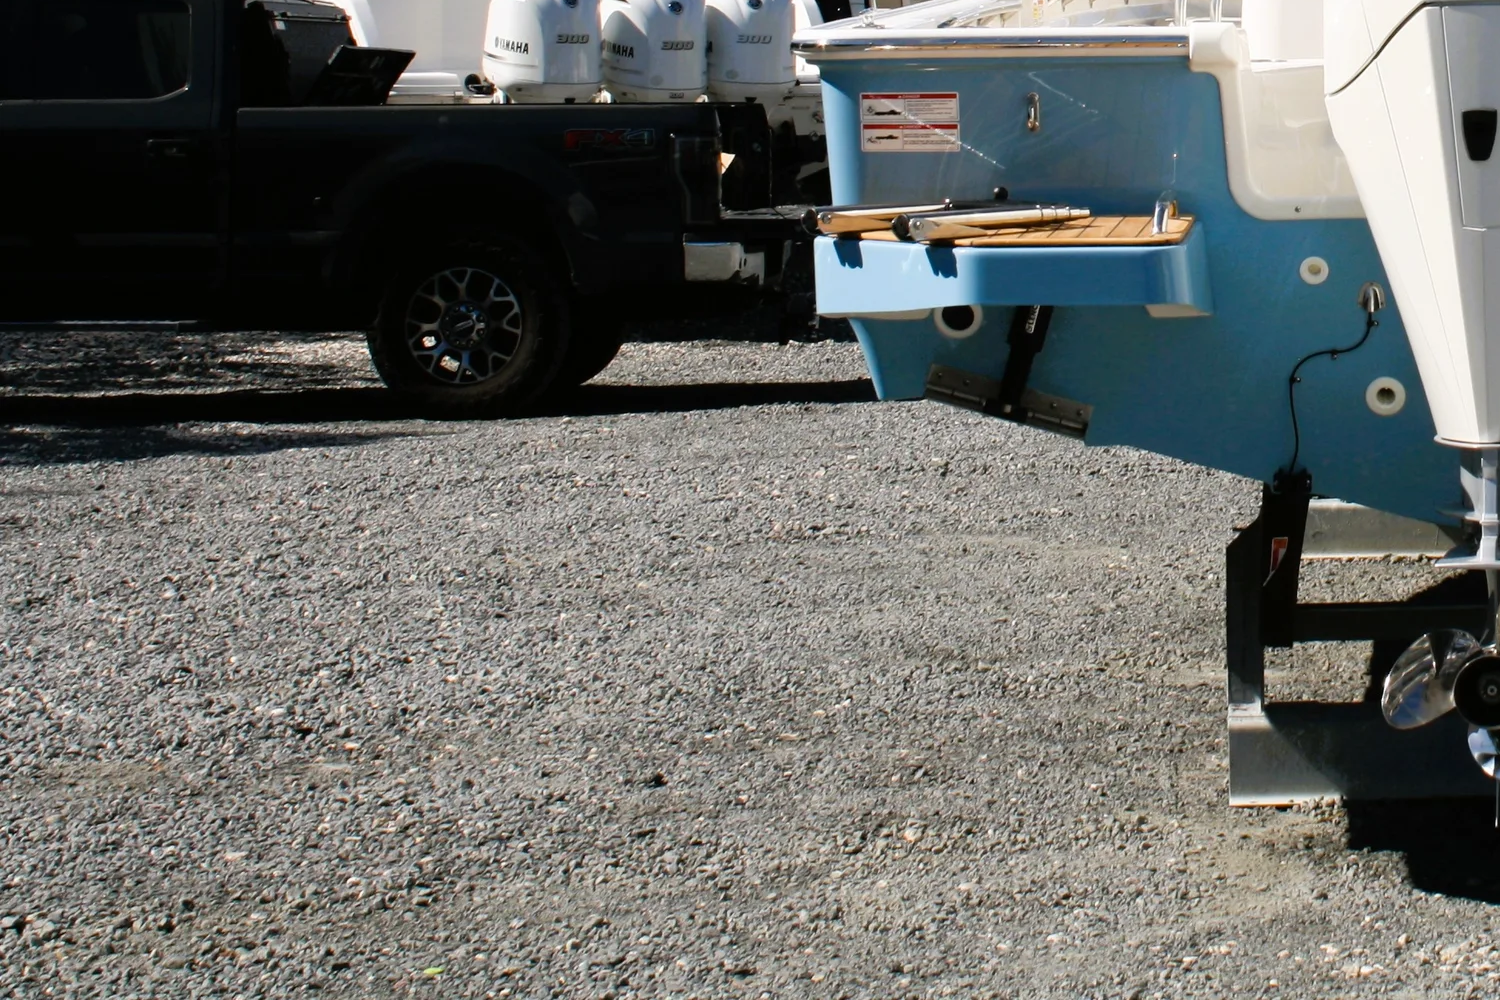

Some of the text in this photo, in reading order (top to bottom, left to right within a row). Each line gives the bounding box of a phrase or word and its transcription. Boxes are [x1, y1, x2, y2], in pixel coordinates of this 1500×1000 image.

[556, 34, 590, 44] 300
[737, 35, 772, 44] 300
[661, 41, 694, 51] 300
[564, 128, 655, 151] FX4
